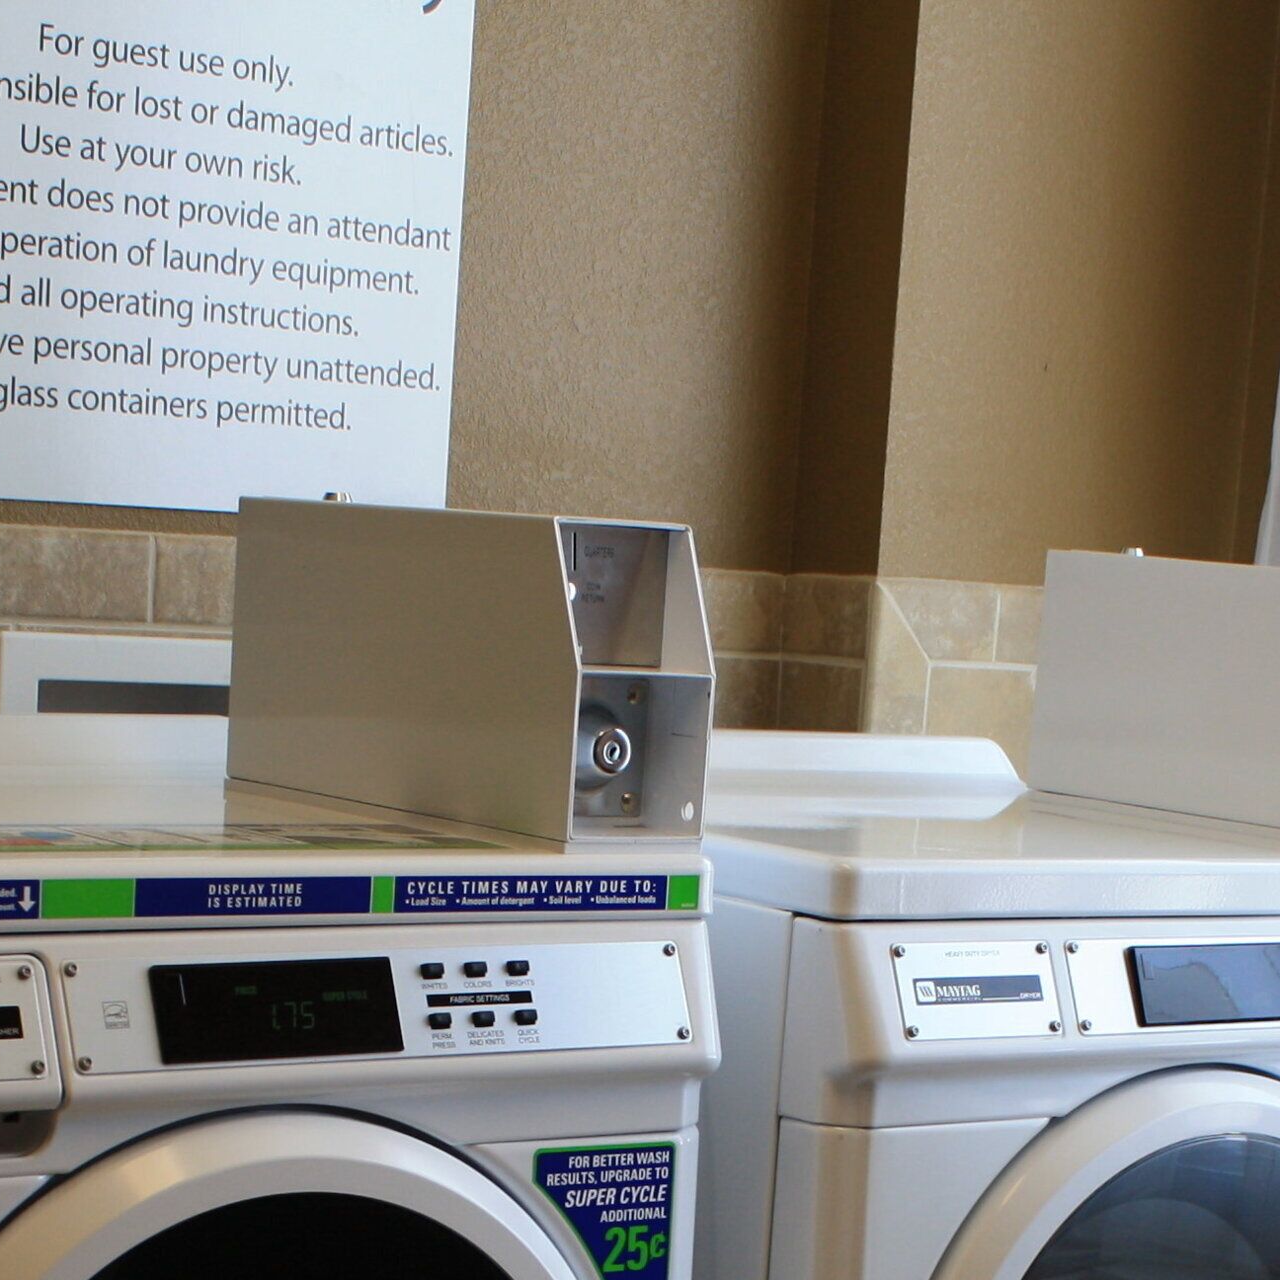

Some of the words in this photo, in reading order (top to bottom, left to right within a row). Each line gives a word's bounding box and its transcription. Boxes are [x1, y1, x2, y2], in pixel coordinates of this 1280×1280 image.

[38, 22, 85, 57] For
[92, 38, 170, 69] guest
[179, 50, 224, 76] use
[232, 54, 293, 92] only.
[86, 79, 126, 113] for
[134, 85, 182, 121] lost
[190, 102, 219, 125] or
[226, 99, 351, 146] damaged
[359, 123, 453, 156] articles.
[20, 122, 72, 158] Use
[79, 136, 107, 162] at
[114, 142, 177, 172] your
[184, 151, 243, 178] own
[253, 154, 301, 185] risk.
[46, 177, 114, 213] does
[123, 194, 170, 220] not
[178, 200, 279, 231] provide
[287, 213, 318, 236] an
[327, 215, 450, 251] attendant
[126, 237, 157, 267] of
[163, 239, 264, 285] laundry
[272, 258, 418, 294] equipment.
[20, 276, 51, 308] all
[60, 288, 193, 328] operating
[203, 294, 358, 336] instructions.
[33, 335, 152, 366] personal
[161, 347, 278, 383] property
[286, 358, 439, 390] unattended.
[67, 387, 207, 419] containers
[216, 399, 350, 430] permitted.
[208, 883, 265, 895] DISPLAY
[270, 882, 302, 894] TIME
[407, 880, 454, 895] CYCLE
[461, 880, 509, 894] TIMES
[516, 880, 548, 894] MAY
[554, 879, 593, 894] VARY
[599, 879, 627, 893] DUE
[633, 879, 656, 893] TO:
[207, 897, 220, 908] IS
[226, 896, 302, 908] ESTIMATED
[463, 980, 493, 989] COLORS
[505, 979, 536, 987] BRIGHTS
[936, 984, 981, 998] MAYTAG
[449, 995, 475, 1004] FABRIC
[476, 994, 510, 1003] SETTINGS
[466, 1030, 505, 1039] DELICATES
[469, 1038, 484, 1047] AND
[485, 1037, 506, 1046] KNITS
[518, 1036, 540, 1044] CYCLE
[568, 1155, 590, 1169] FOR
[592, 1152, 634, 1168] BETTER
[636, 1150, 670, 1165] WASH
[546, 1170, 598, 1186] RESULTS,
[600, 1167, 653, 1183] UPGRADE
[654, 1166, 669, 1179] TO
[564, 1187, 617, 1208] SUPER
[619, 1183, 668, 1204] CYCLE
[599, 1206, 666, 1223] ADDITIONAL
[602, 1224, 667, 1273] 25¢
